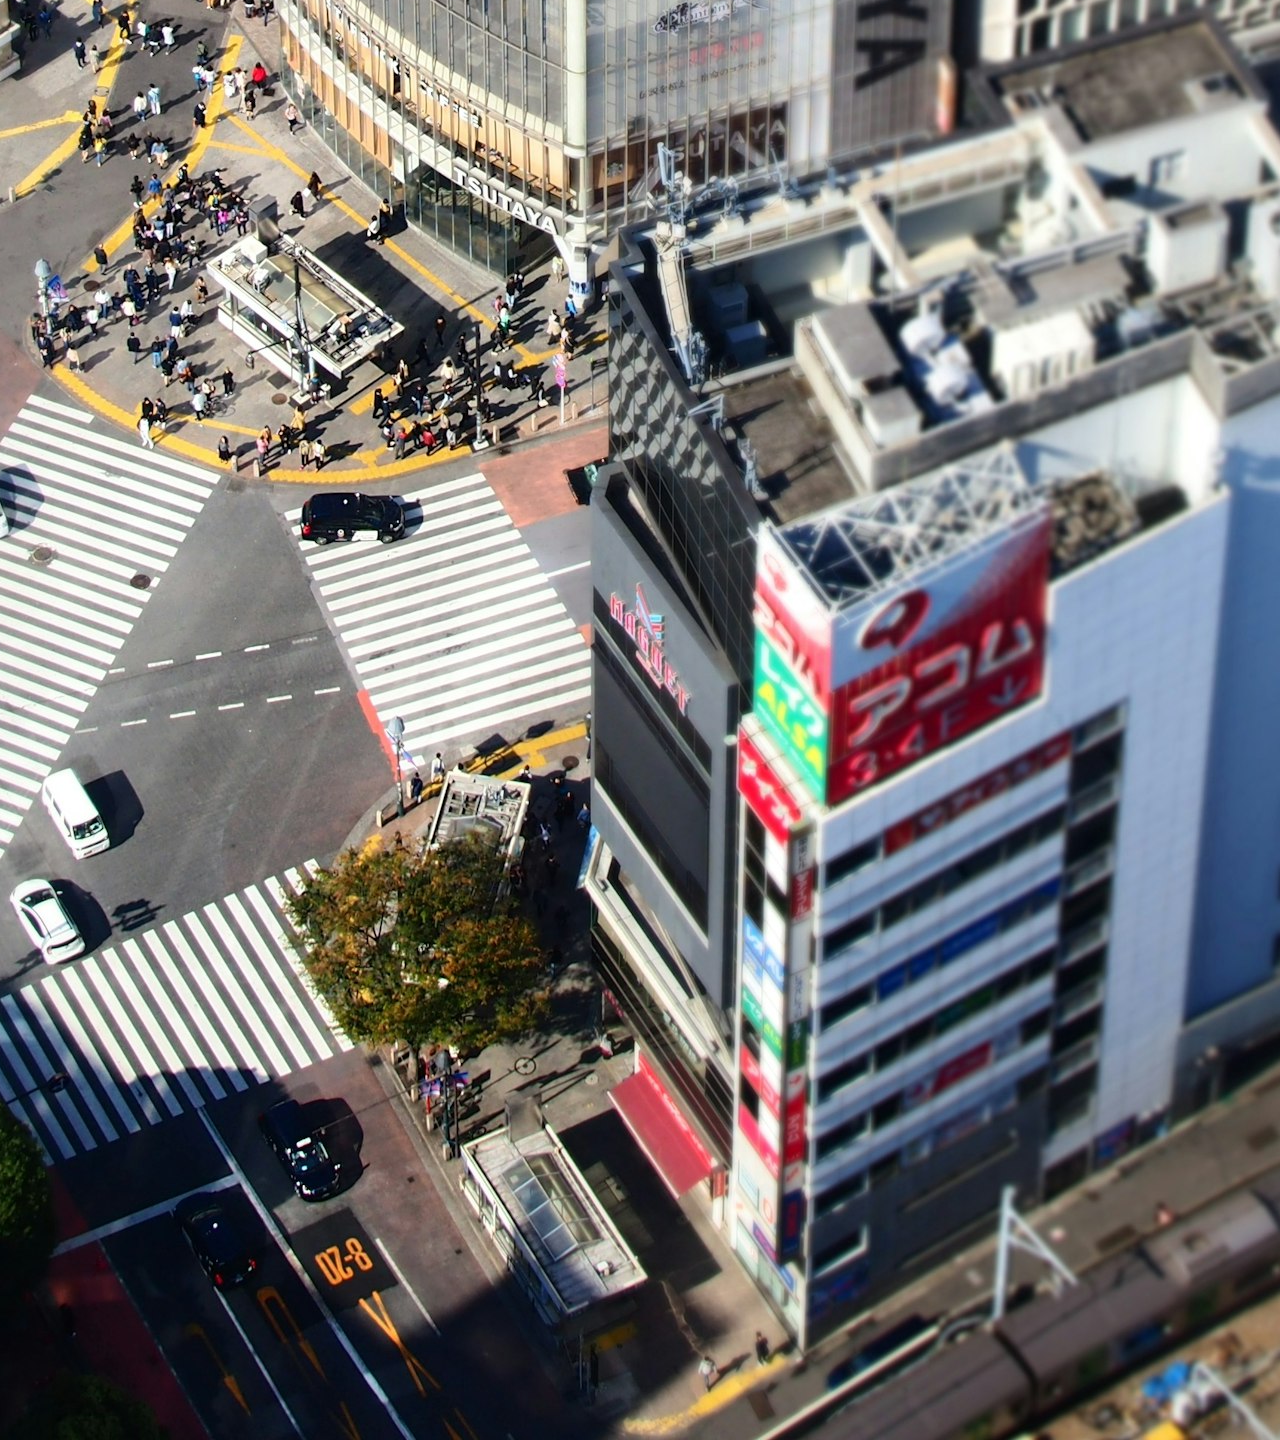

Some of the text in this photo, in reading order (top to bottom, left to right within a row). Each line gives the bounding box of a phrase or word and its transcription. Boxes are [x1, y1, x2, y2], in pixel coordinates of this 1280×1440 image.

[453, 166, 559, 236] TSUTAYA
[757, 681, 823, 779] ALSA
[759, 640, 824, 738] レイク
[848, 616, 1037, 748] アコム
[315, 1237, 374, 1286] 8-20
